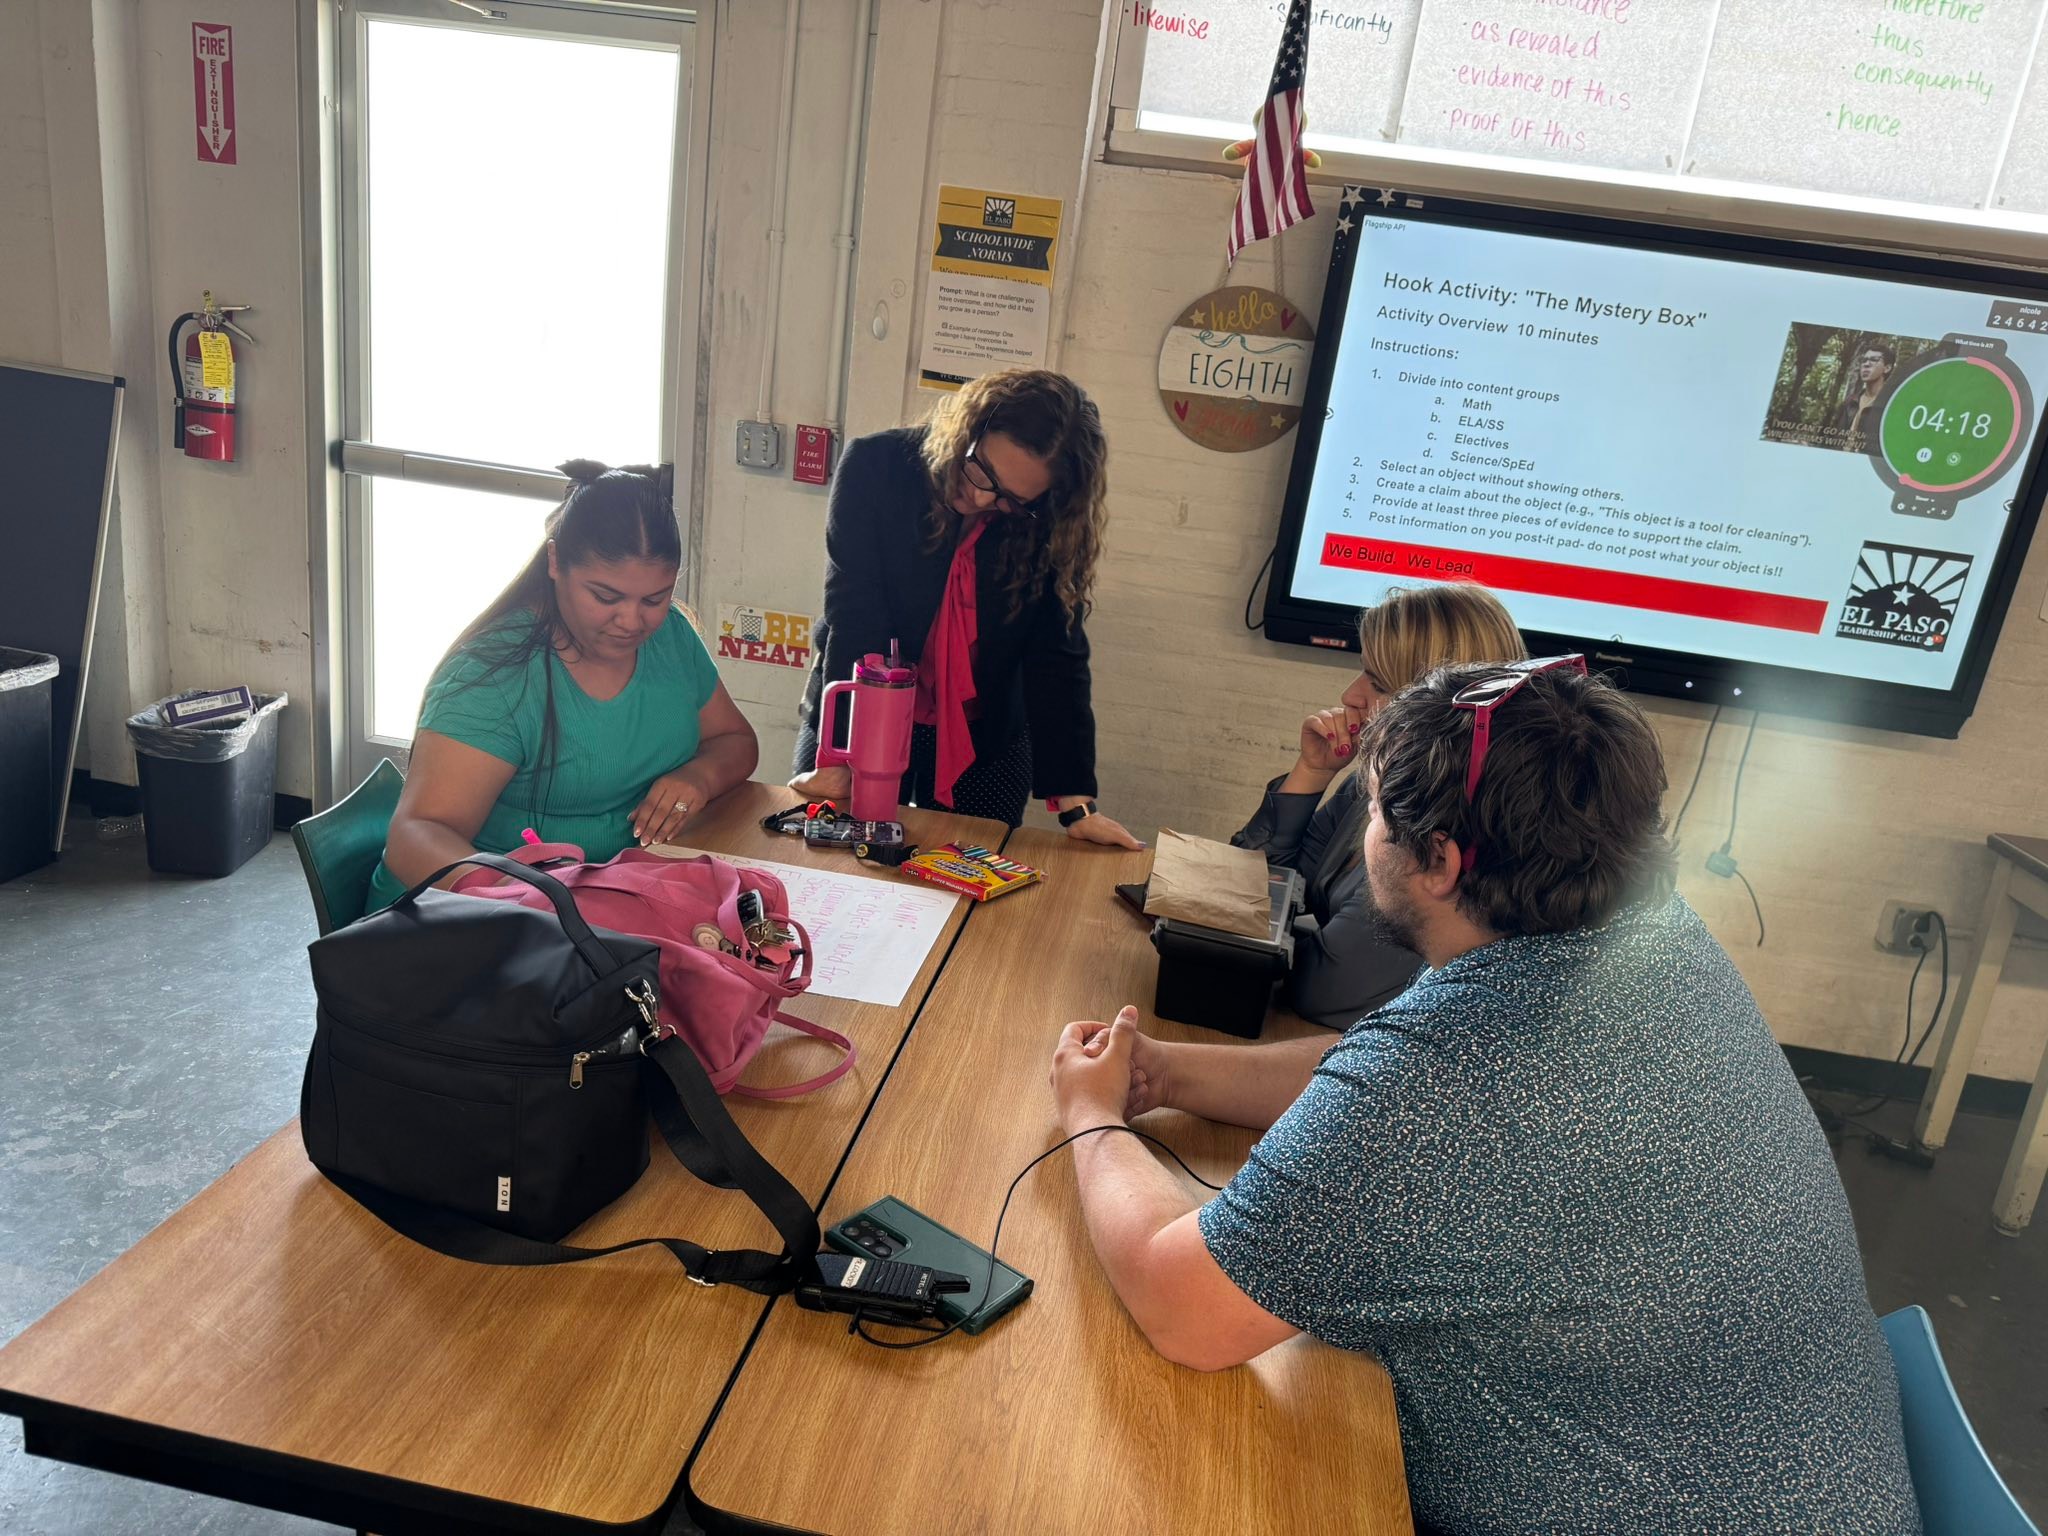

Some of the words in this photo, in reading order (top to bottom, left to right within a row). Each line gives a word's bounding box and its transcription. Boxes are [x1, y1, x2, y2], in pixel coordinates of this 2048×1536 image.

[1133, 5, 1210, 40] likewise
[199, 36, 226, 56] FIRE
[1471, 21, 1500, 42] as
[1509, 28, 1600, 58] revealed
[1872, 23, 1924, 59] thus
[1458, 64, 1544, 93] evidence
[1584, 79, 1631, 111] this
[1854, 60, 1994, 105] consequently
[209, 59, 220, 150] EXTINGUISHER
[1837, 104, 1901, 138] hence
[1450, 108, 1500, 132] proof
[1544, 119, 1586, 151] this
[954, 230, 1036, 251] SCHOOLWIDE
[1365, 219, 1392, 230] Flagship
[968, 247, 1014, 263] NORMS
[938, 304, 948, 312] you
[976, 309, 1000, 317] person?
[939, 286, 964, 296] Prompt:
[964, 289, 980, 297] What
[997, 293, 1024, 303] challenge
[1021, 305, 1034, 313] help
[1211, 291, 1279, 331] hello
[1383, 272, 1434, 294] Hook
[1439, 279, 1518, 307] Activity:
[1525, 290, 1569, 312] "The
[1575, 296, 1652, 326] Mystery
[1657, 307, 1708, 328] Box"
[948, 324, 971, 333] Example
[1376, 305, 1434, 327] Activity
[1438, 312, 1509, 335] Overview
[1517, 323, 1536, 337] 10
[1538, 326, 1600, 346] minutes
[1015, 349, 1032, 357] helped
[1370, 337, 1460, 360] Instructions:
[1189, 353, 1292, 396] EIGHTH
[1371, 368, 1382, 380] 1.
[1398, 371, 1437, 387] Divide
[1439, 376, 1464, 390] into
[1466, 380, 1514, 397] content
[1516, 387, 1561, 403] groups
[1434, 396, 1445, 407] a.
[1461, 397, 1493, 412] Math
[1430, 412, 1441, 424] b.
[1458, 416, 1505, 431] ELA/SS
[1908, 405, 1992, 438] 04:18
[1427, 431, 1437, 441] c.
[1454, 433, 1509, 450] Electives
[799, 462, 822, 470] ALARM
[1422, 448, 1434, 459] d.
[1450, 451, 1535, 472] Science/SpEd
[1353, 456, 1363, 468] 2.
[1380, 460, 1417, 475] Select
[1419, 466, 1434, 476] an
[1438, 468, 1476, 483] object
[1479, 473, 1525, 489] without
[1527, 479, 1579, 498] showing
[1582, 487, 1624, 502] others.
[1346, 491, 1356, 503] 4.
[1372, 494, 1419, 510] Provide
[1421, 501, 1434, 512] at
[1436, 503, 1466, 516] least
[1468, 506, 1500, 521] three
[1501, 511, 1543, 529] pieces
[1544, 516, 1559, 529] of
[1560, 521, 1614, 537] evidence
[1618, 526, 1631, 539] to
[1633, 529, 1682, 547] support
[1684, 535, 1704, 549] the
[1705, 539, 1743, 555] claim.
[1349, 474, 1360, 485] 3.
[1377, 477, 1415, 492] Create
[1417, 484, 1426, 493] a
[1429, 484, 1461, 498] claim
[1464, 489, 1499, 503] about
[1502, 492, 1521, 505] the
[1524, 496, 1562, 512] object
[1564, 502, 1594, 517] (e.g.,
[1599, 506, 1630, 521] "This
[1634, 511, 1672, 526] object
[1674, 517, 1685, 528] is
[1688, 520, 1696, 530] a
[1699, 521, 1724, 534] tool
[1726, 524, 1744, 536] for
[1746, 527, 1812, 548] cleaning").
[1328, 541, 1353, 559] We
[1356, 547, 1397, 565] Build.
[1406, 553, 1432, 570] We
[1435, 556, 1476, 576] Lead.
[1342, 507, 1353, 519] 5.
[1369, 511, 1396, 525] Post
[1398, 515, 1468, 535] information
[1471, 526, 1487, 537] on
[1489, 528, 1513, 542] you
[1514, 531, 1555, 548] post-it
[1556, 535, 1585, 552] pad-
[1587, 539, 1603, 552] do
[1606, 544, 1627, 557] not
[1628, 547, 1657, 561] post
[1659, 551, 1689, 566] what
[1690, 555, 1721, 571] your
[1722, 558, 1760, 575] object
[1762, 564, 1783, 578] is!!
[764, 612, 810, 649] BE
[1838, 624, 1897, 640] LEADERSHIP
[1840, 605, 1875, 627] EL
[1881, 611, 1950, 635] PASO
[718, 635, 810, 668] NEAT
[888, 893, 942, 930] Claim:
[824, 943, 856, 965] used
[817, 965, 850, 985] for
